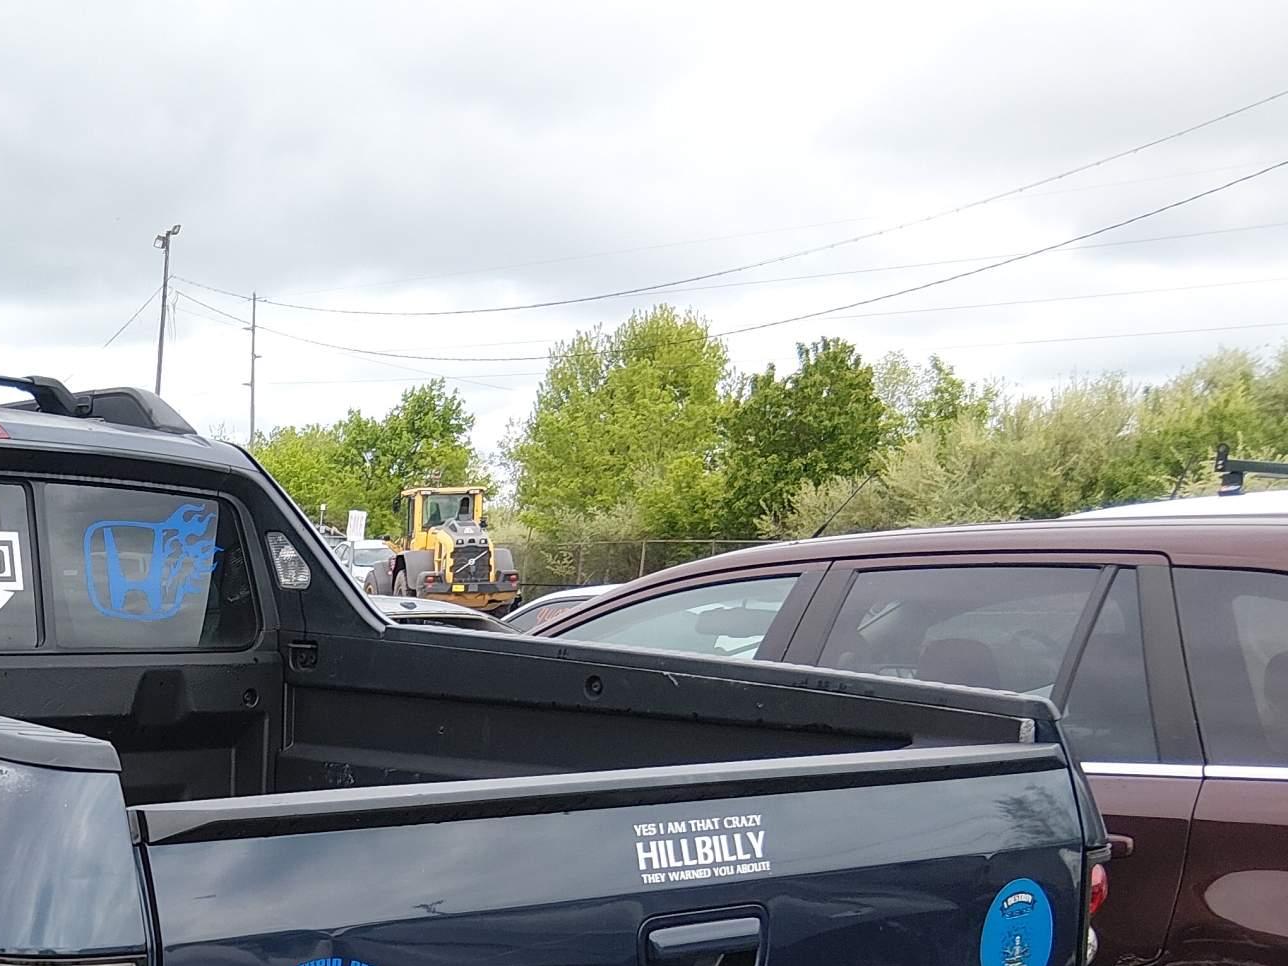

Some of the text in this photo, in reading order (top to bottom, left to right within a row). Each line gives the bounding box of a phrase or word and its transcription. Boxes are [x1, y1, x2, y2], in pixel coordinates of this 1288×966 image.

[634, 814, 762, 837] YES I AM THAT CRAZY
[635, 830, 766, 871] HILLBILLY
[641, 860, 771, 884] THEY WARNED YOU ABOUT!
